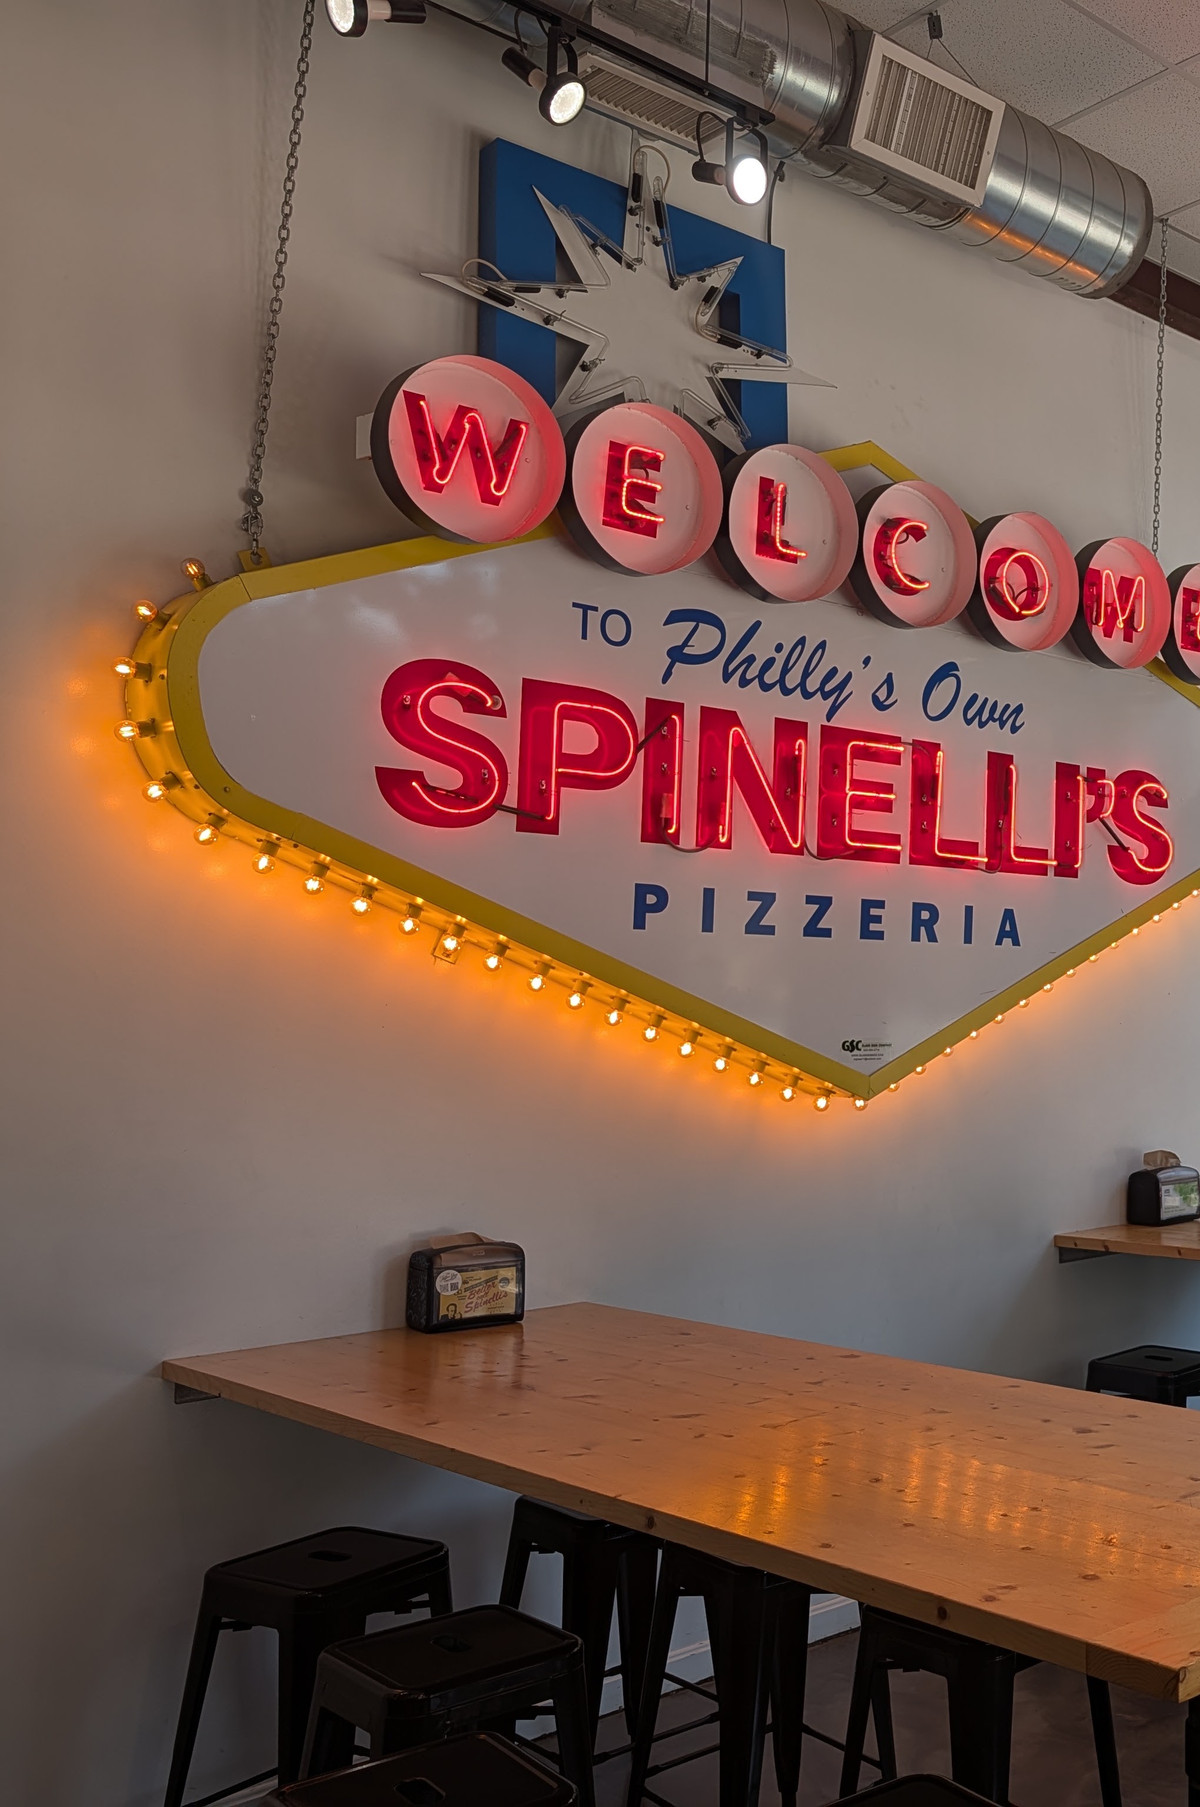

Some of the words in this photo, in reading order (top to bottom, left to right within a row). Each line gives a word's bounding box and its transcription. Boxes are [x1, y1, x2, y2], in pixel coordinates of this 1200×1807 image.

[571, 601, 632, 648] TO
[661, 608, 898, 722] Philly's
[921, 660, 1027, 735] Own
[374, 658, 1175, 887] SPINELLI'S
[632, 883, 1022, 948] PIZZERIA
